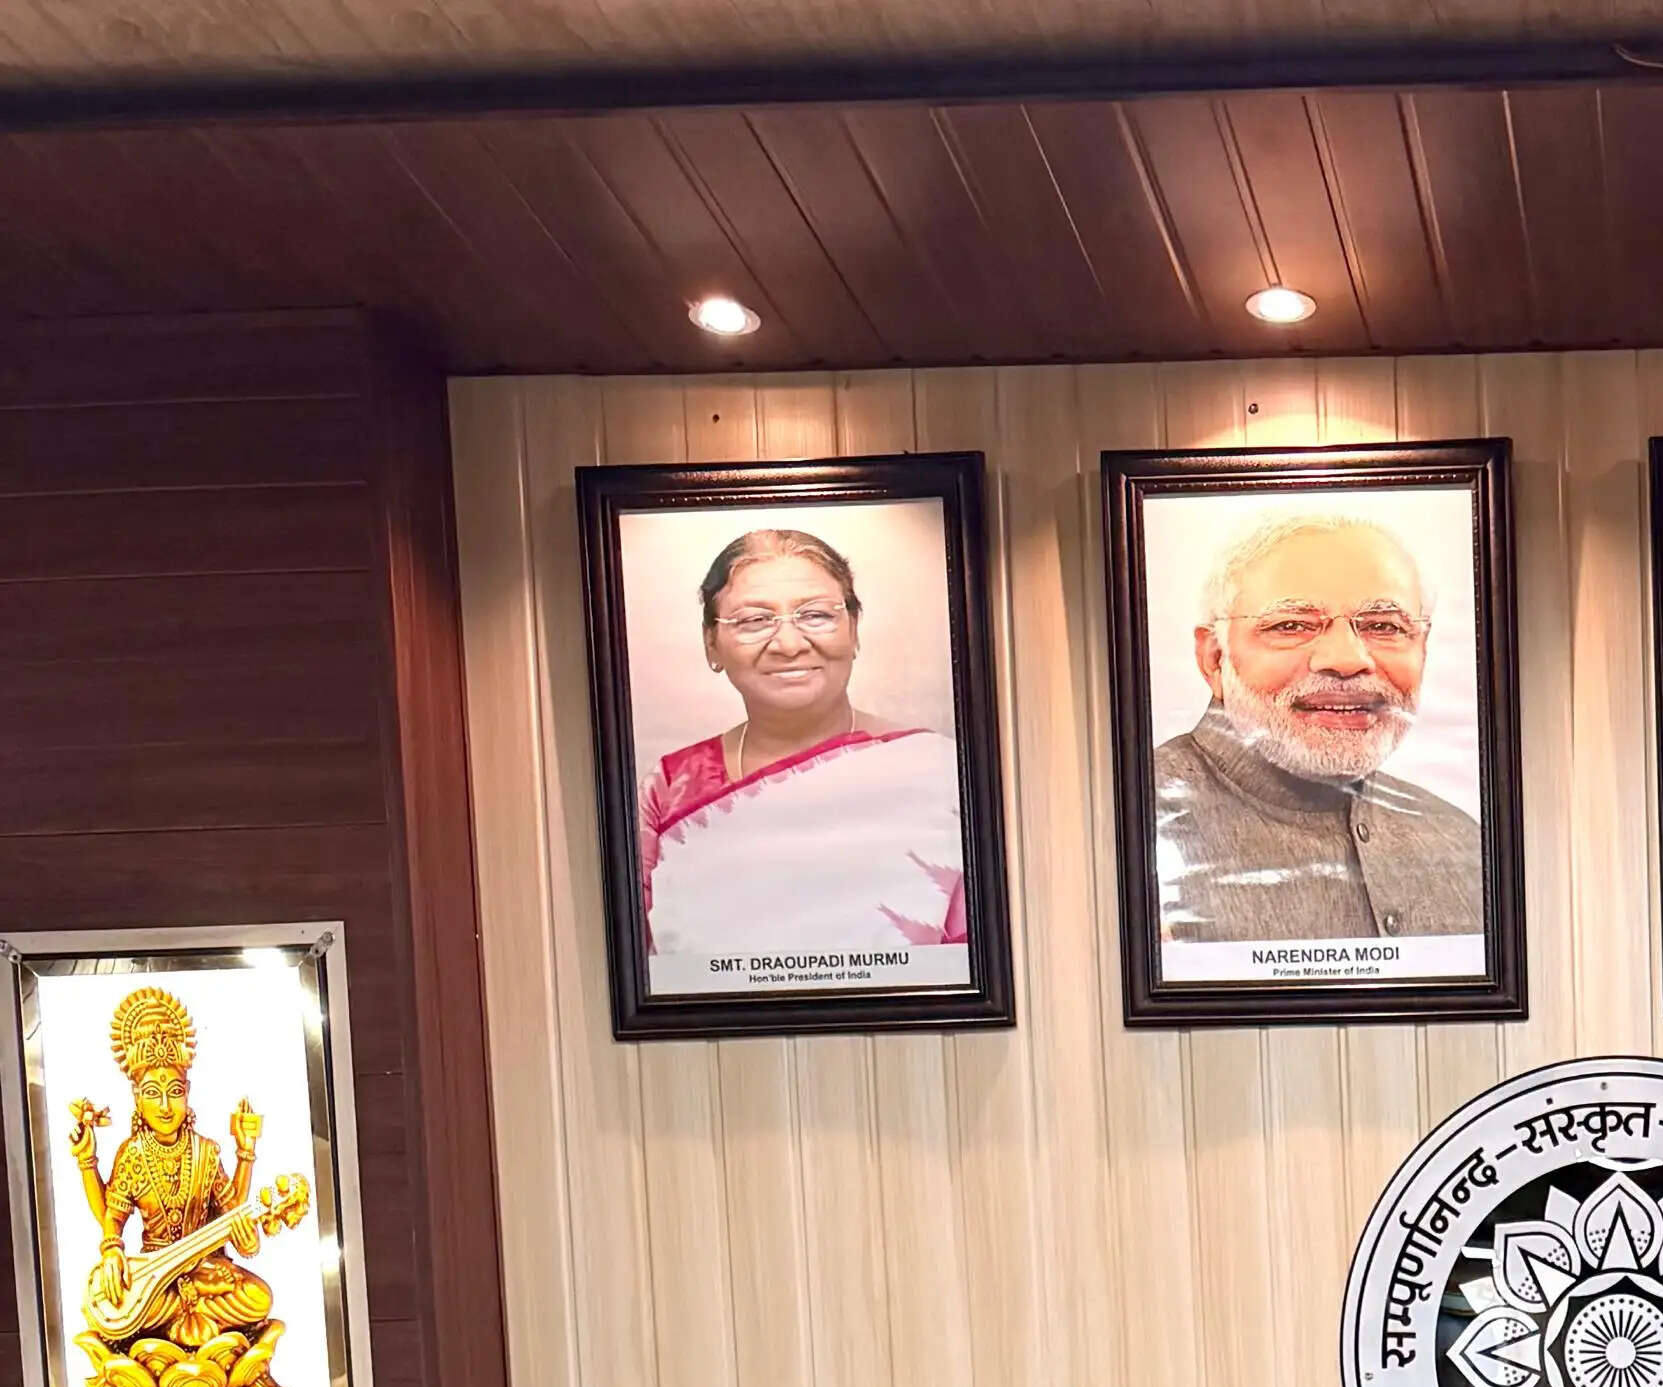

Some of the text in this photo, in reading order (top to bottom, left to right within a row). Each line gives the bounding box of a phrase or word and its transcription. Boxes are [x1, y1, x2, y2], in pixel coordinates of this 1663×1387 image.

[710, 952, 910, 972] SMT. DRAOUPADI MURMU
[1252, 947, 1400, 964] NARENDRA MODI
[788, 972, 833, 982] President
[835, 972, 846, 980] of
[848, 971, 871, 980] India
[1273, 966, 1380, 977] Prime Minister of India
